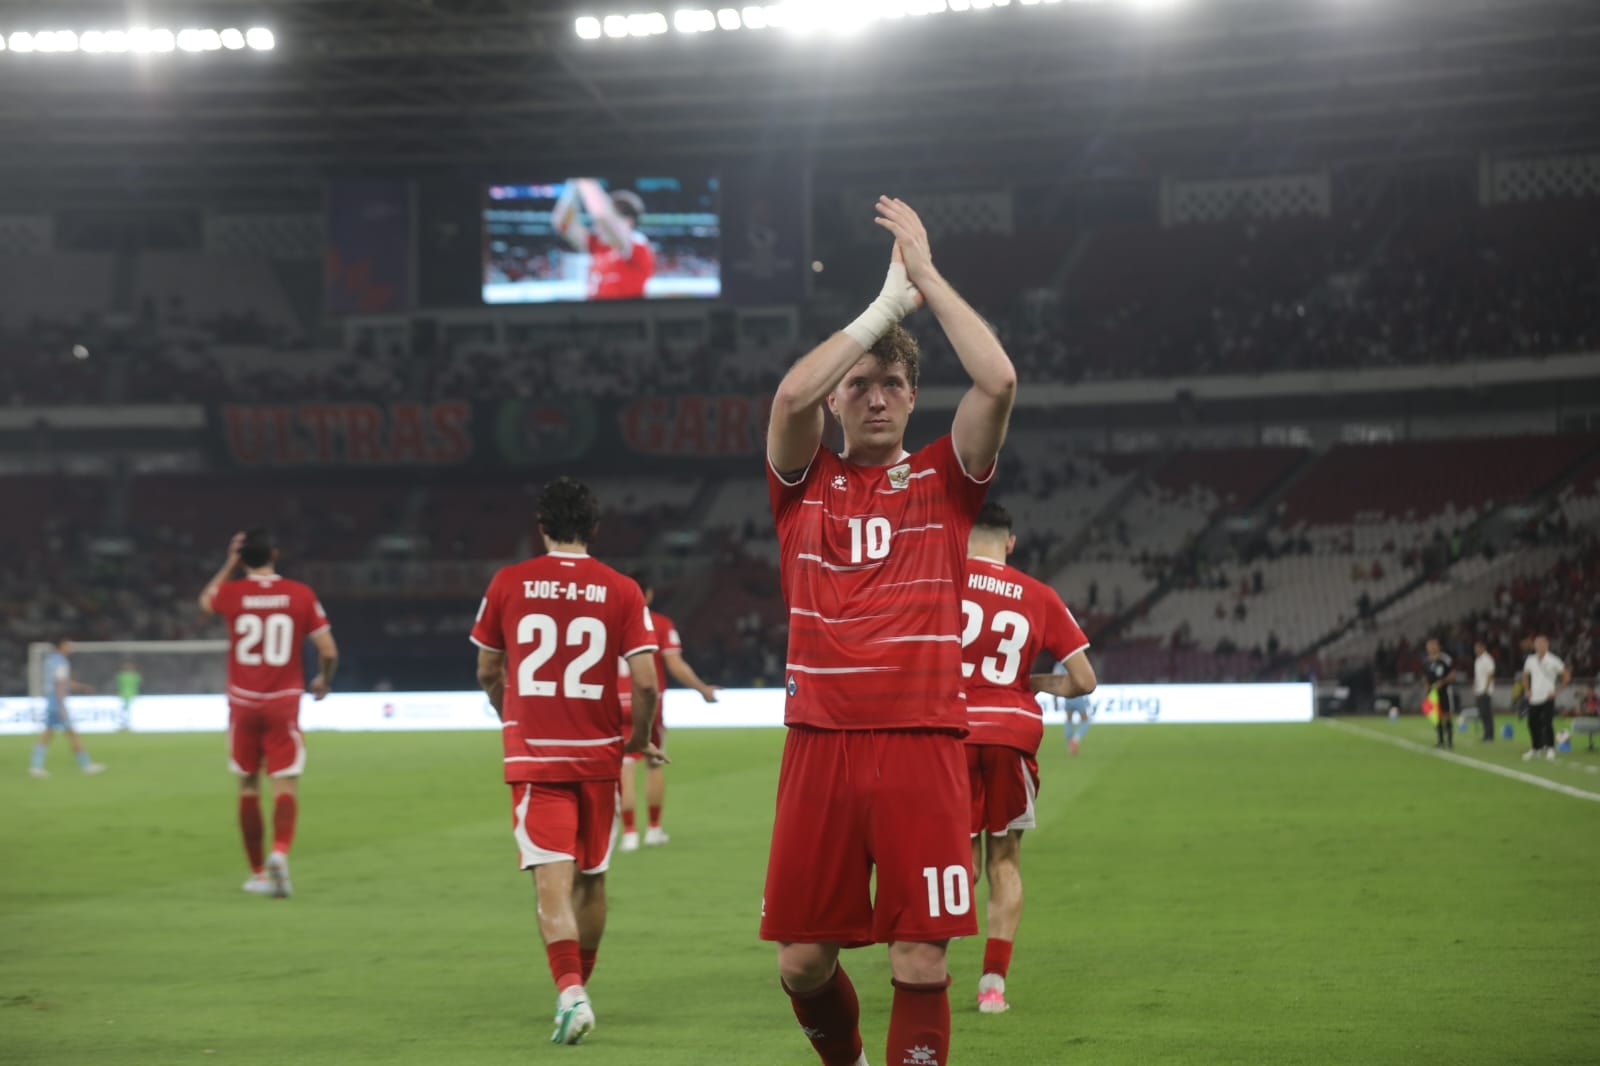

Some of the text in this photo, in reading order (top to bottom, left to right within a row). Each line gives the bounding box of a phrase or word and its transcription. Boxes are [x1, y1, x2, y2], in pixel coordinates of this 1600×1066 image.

[226, 396, 770, 463] ULTRAS GAR
[848, 516, 891, 563] 10
[523, 580, 607, 603] TJOE-A-ON
[968, 573, 1023, 600] HUBNER
[235, 612, 295, 667] 20
[517, 613, 607, 700] 22
[961, 599, 1030, 685] 23
[923, 864, 970, 917] 10
